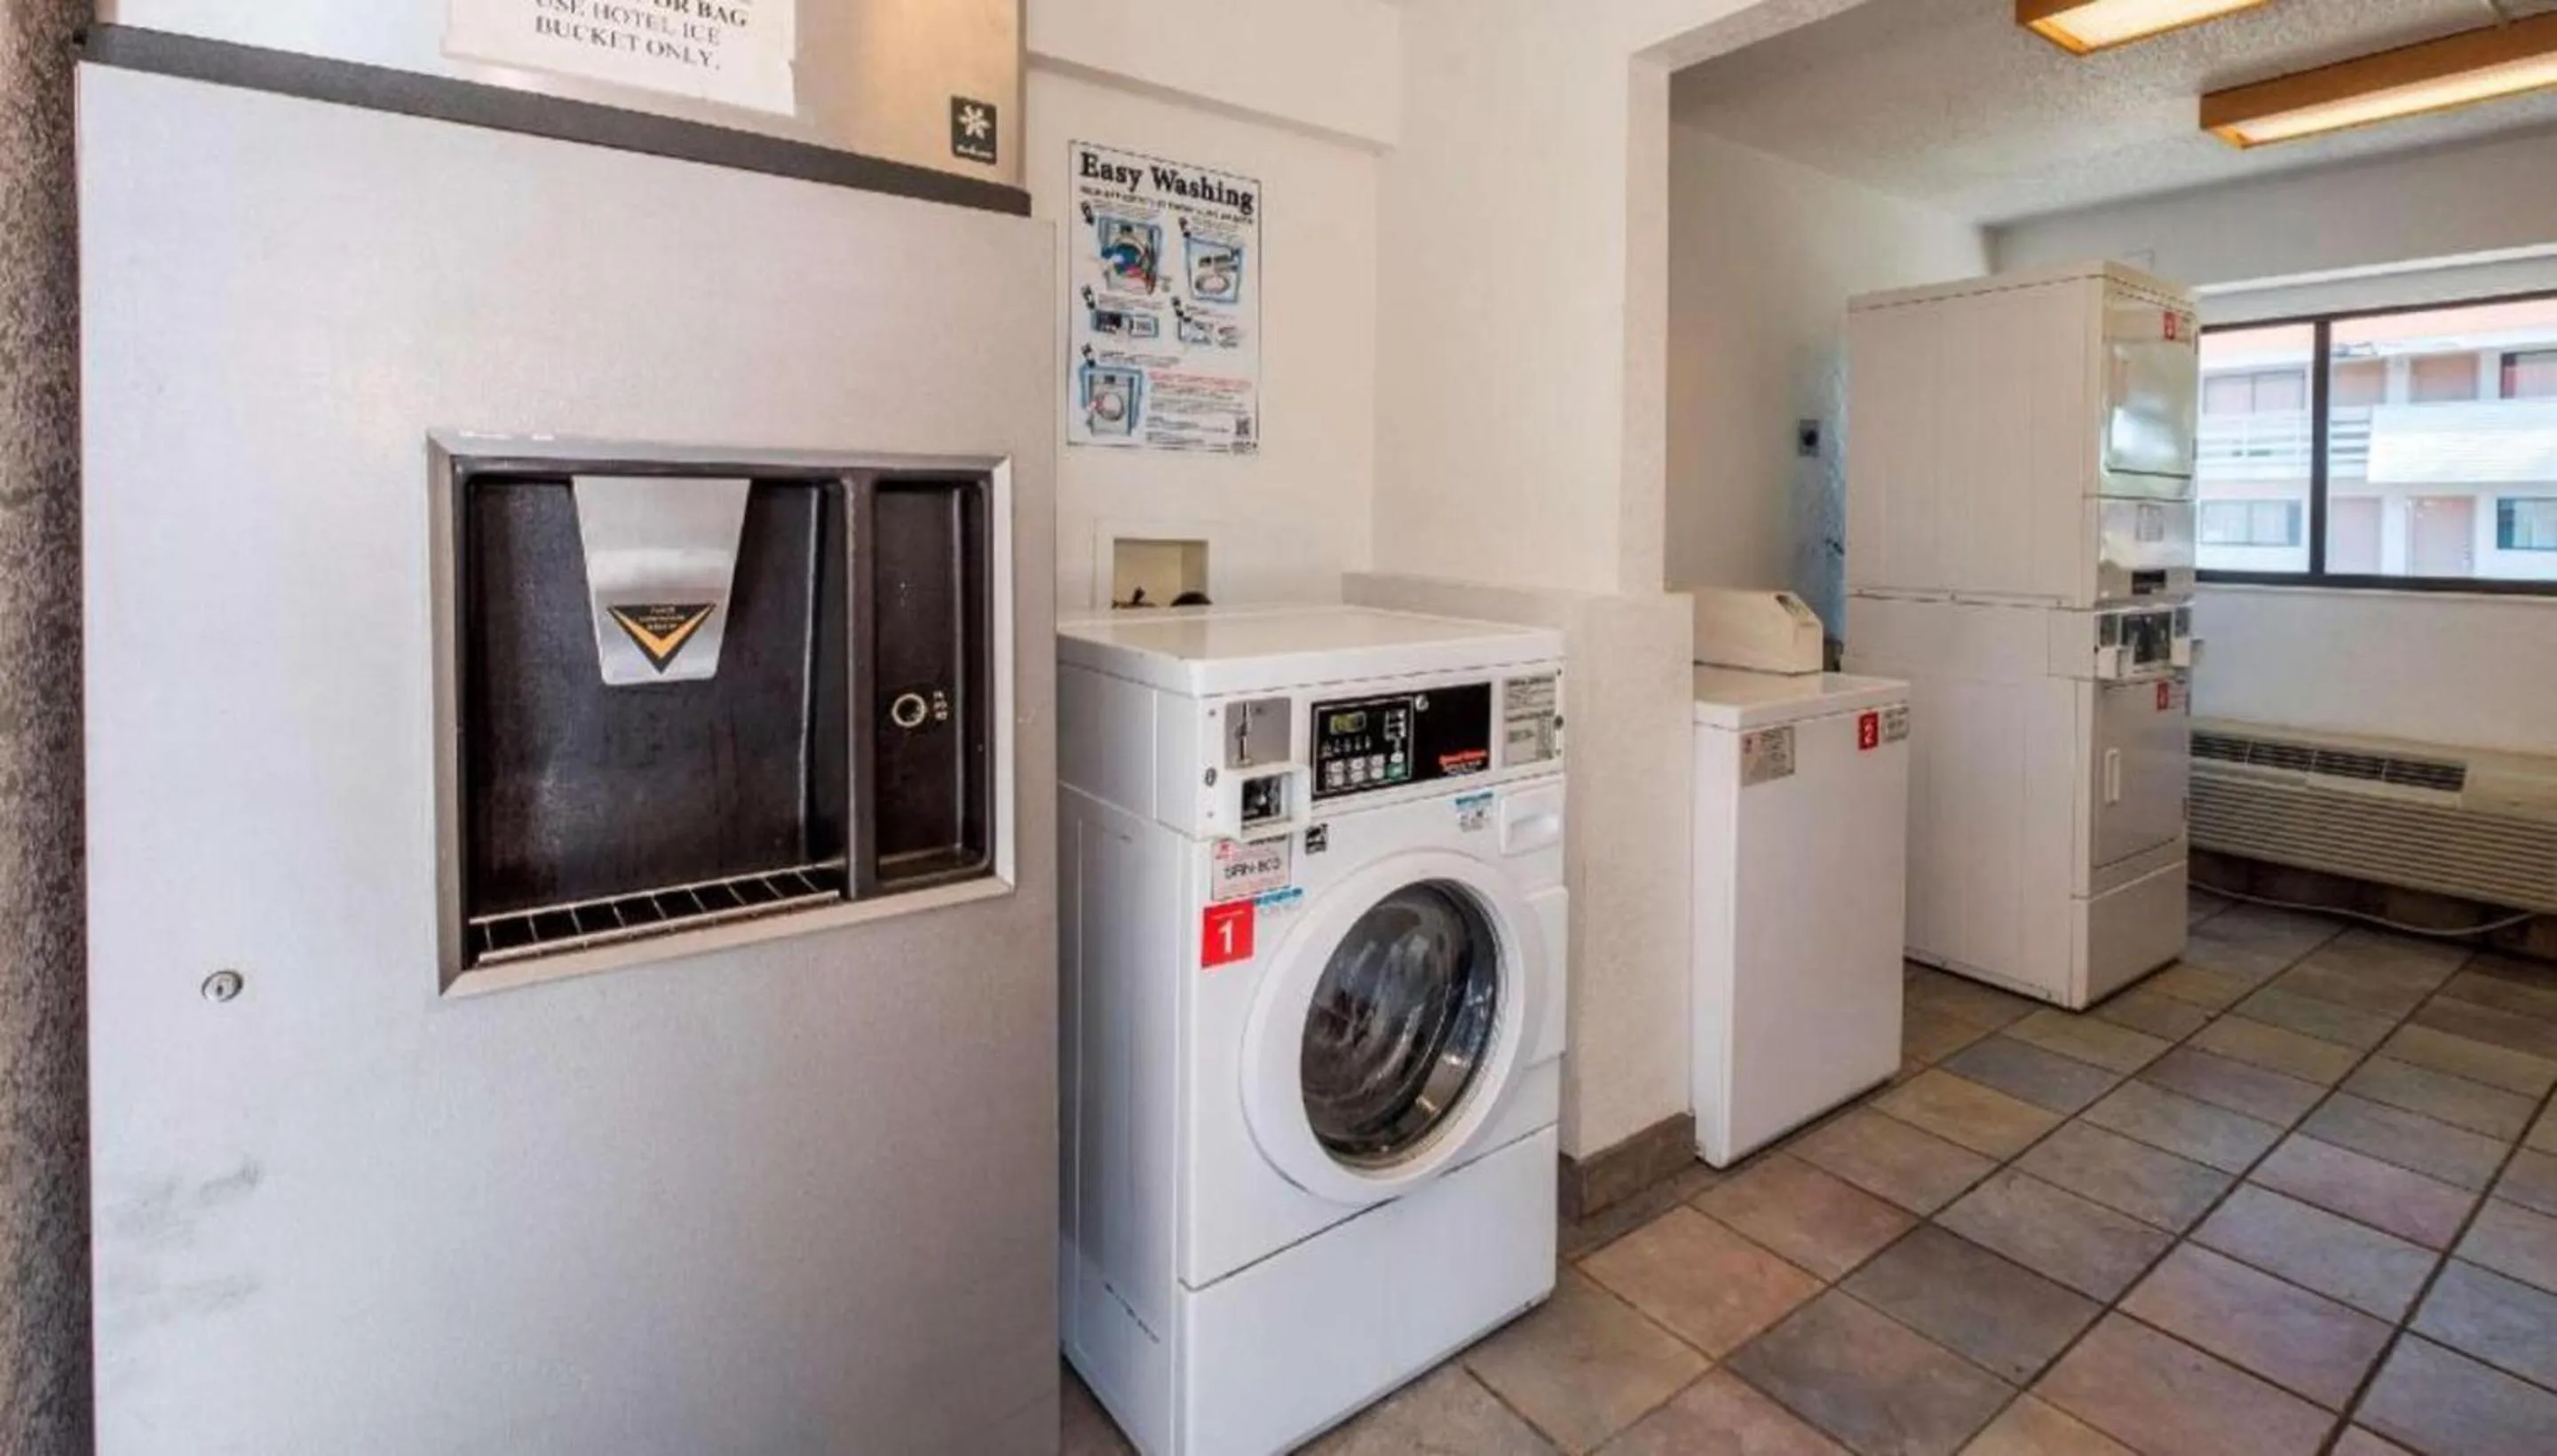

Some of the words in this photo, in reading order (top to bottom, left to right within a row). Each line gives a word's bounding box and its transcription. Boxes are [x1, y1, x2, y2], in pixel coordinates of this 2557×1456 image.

[593, 3, 676, 36] HOTEL
[683, 22, 721, 44] ICE
[698, 1, 748, 27] BAG
[535, 15, 640, 51] BUCKET
[645, 39, 720, 70] ONLY.
[1080, 151, 1143, 193] Easy
[1150, 164, 1255, 216] Washing
[1217, 918, 1233, 954] 1
